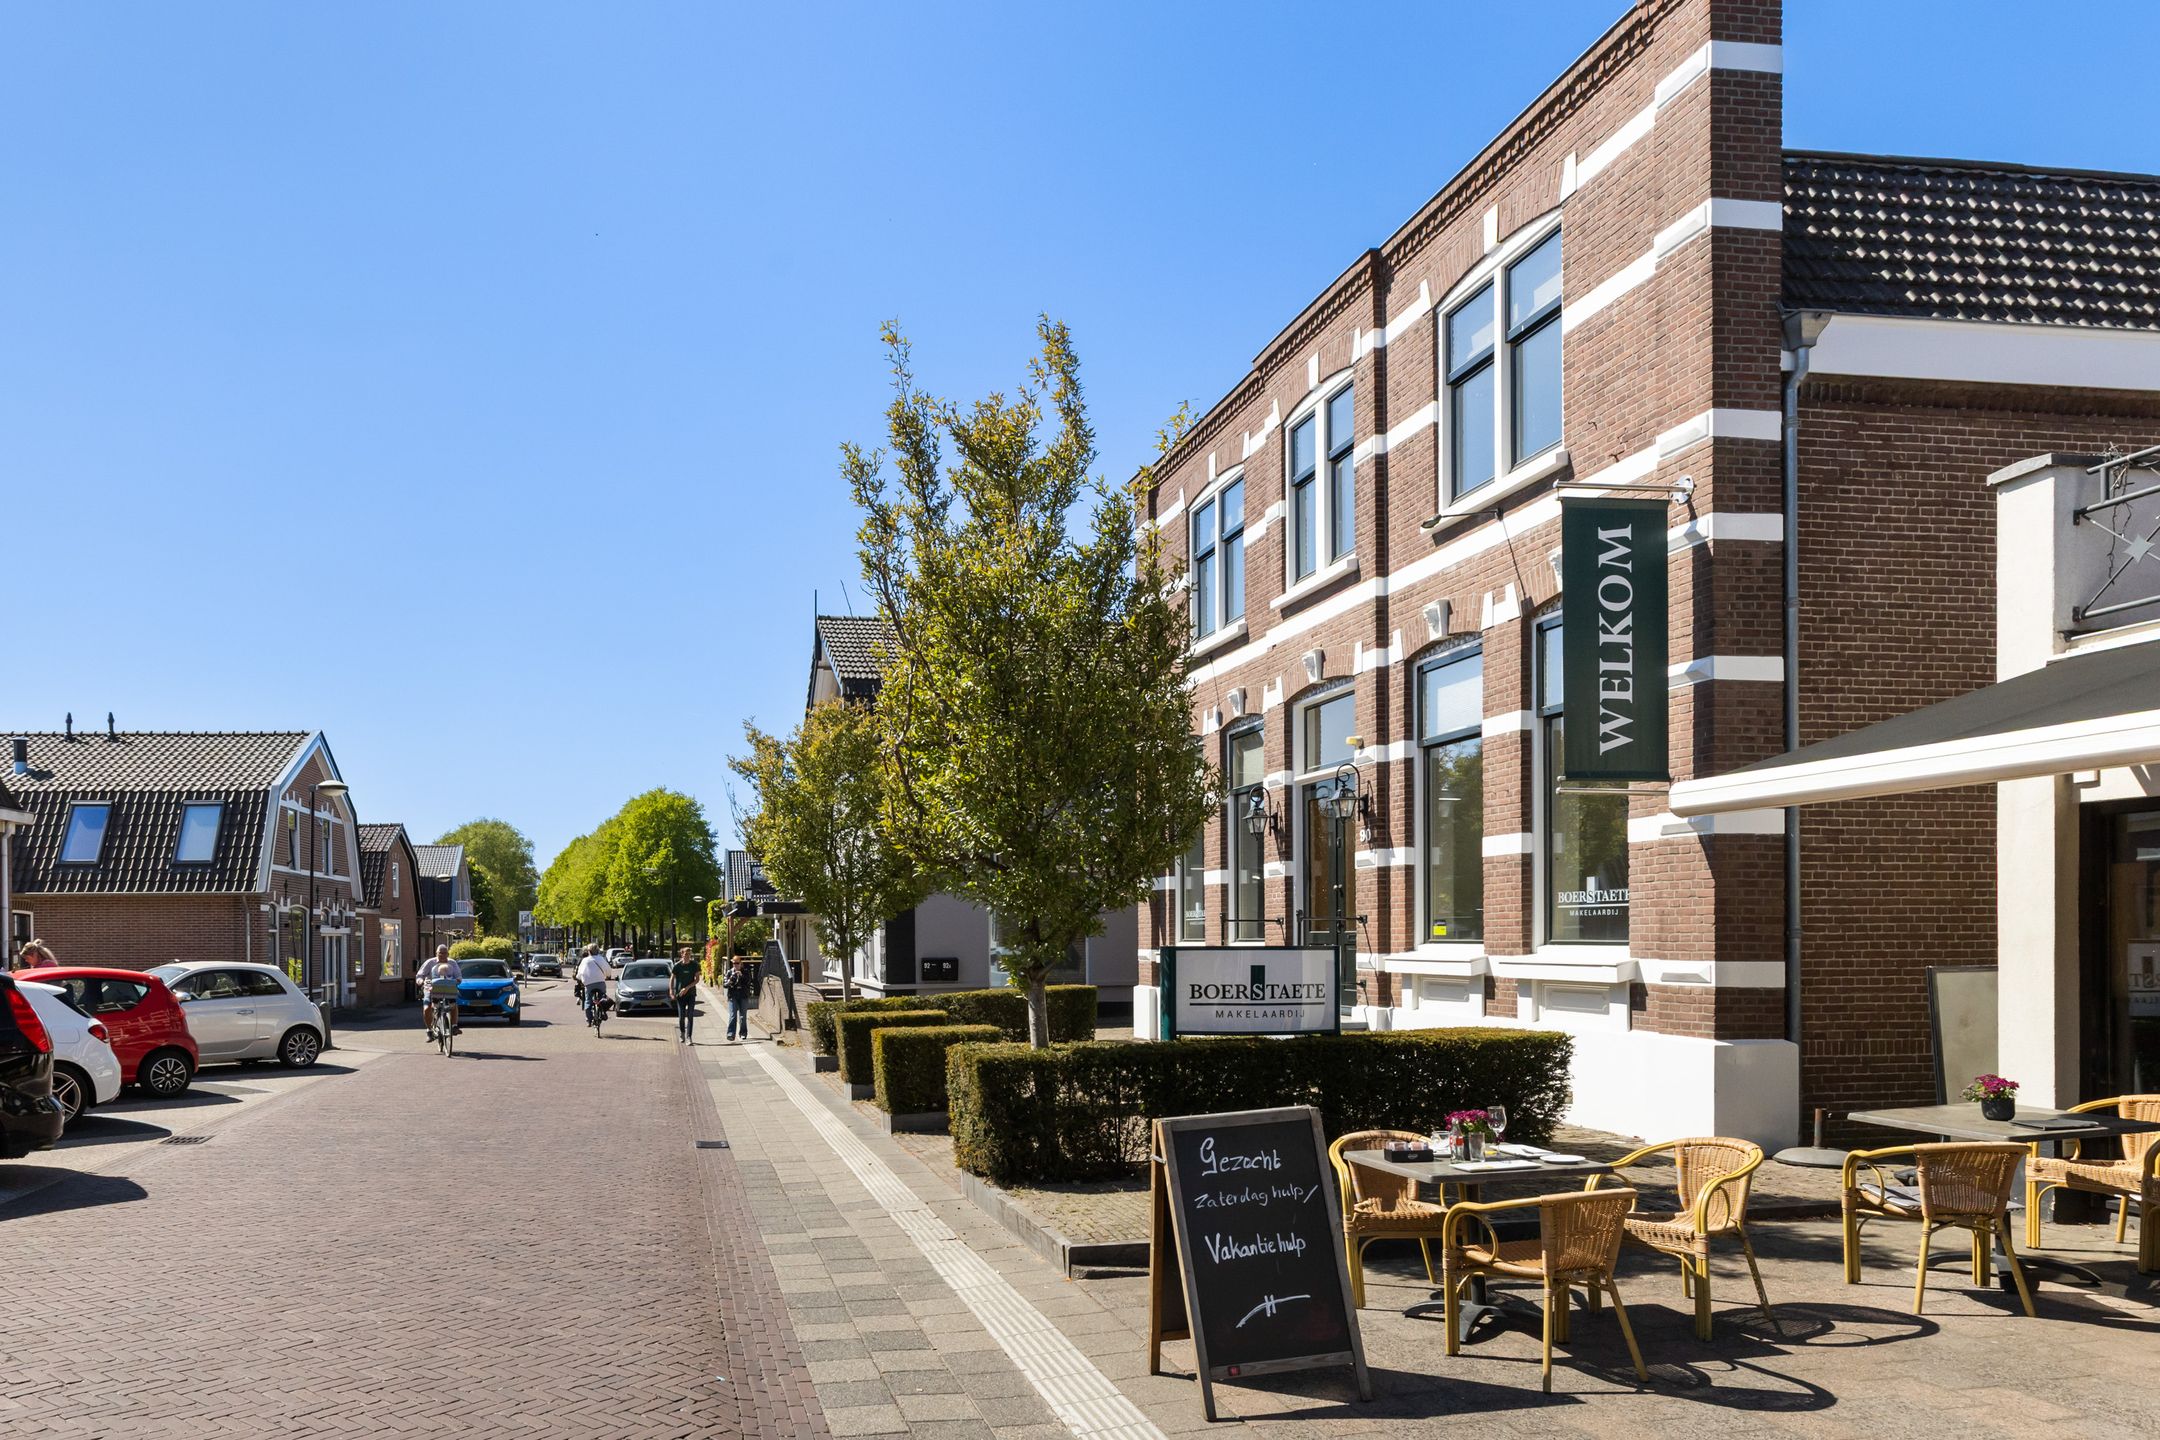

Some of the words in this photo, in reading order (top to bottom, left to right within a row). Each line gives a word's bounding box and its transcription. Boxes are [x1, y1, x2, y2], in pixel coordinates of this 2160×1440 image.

[1597, 523, 1634, 756] WELKOM
[1359, 828, 1372, 843] 90
[1569, 909, 1619, 917] MAKELAARDIJ
[1189, 983, 1326, 1000] BOERSTAETE
[1215, 1009, 1306, 1019] MAKELAARDIJ
[1199, 1137, 1282, 1176] Gezocht
